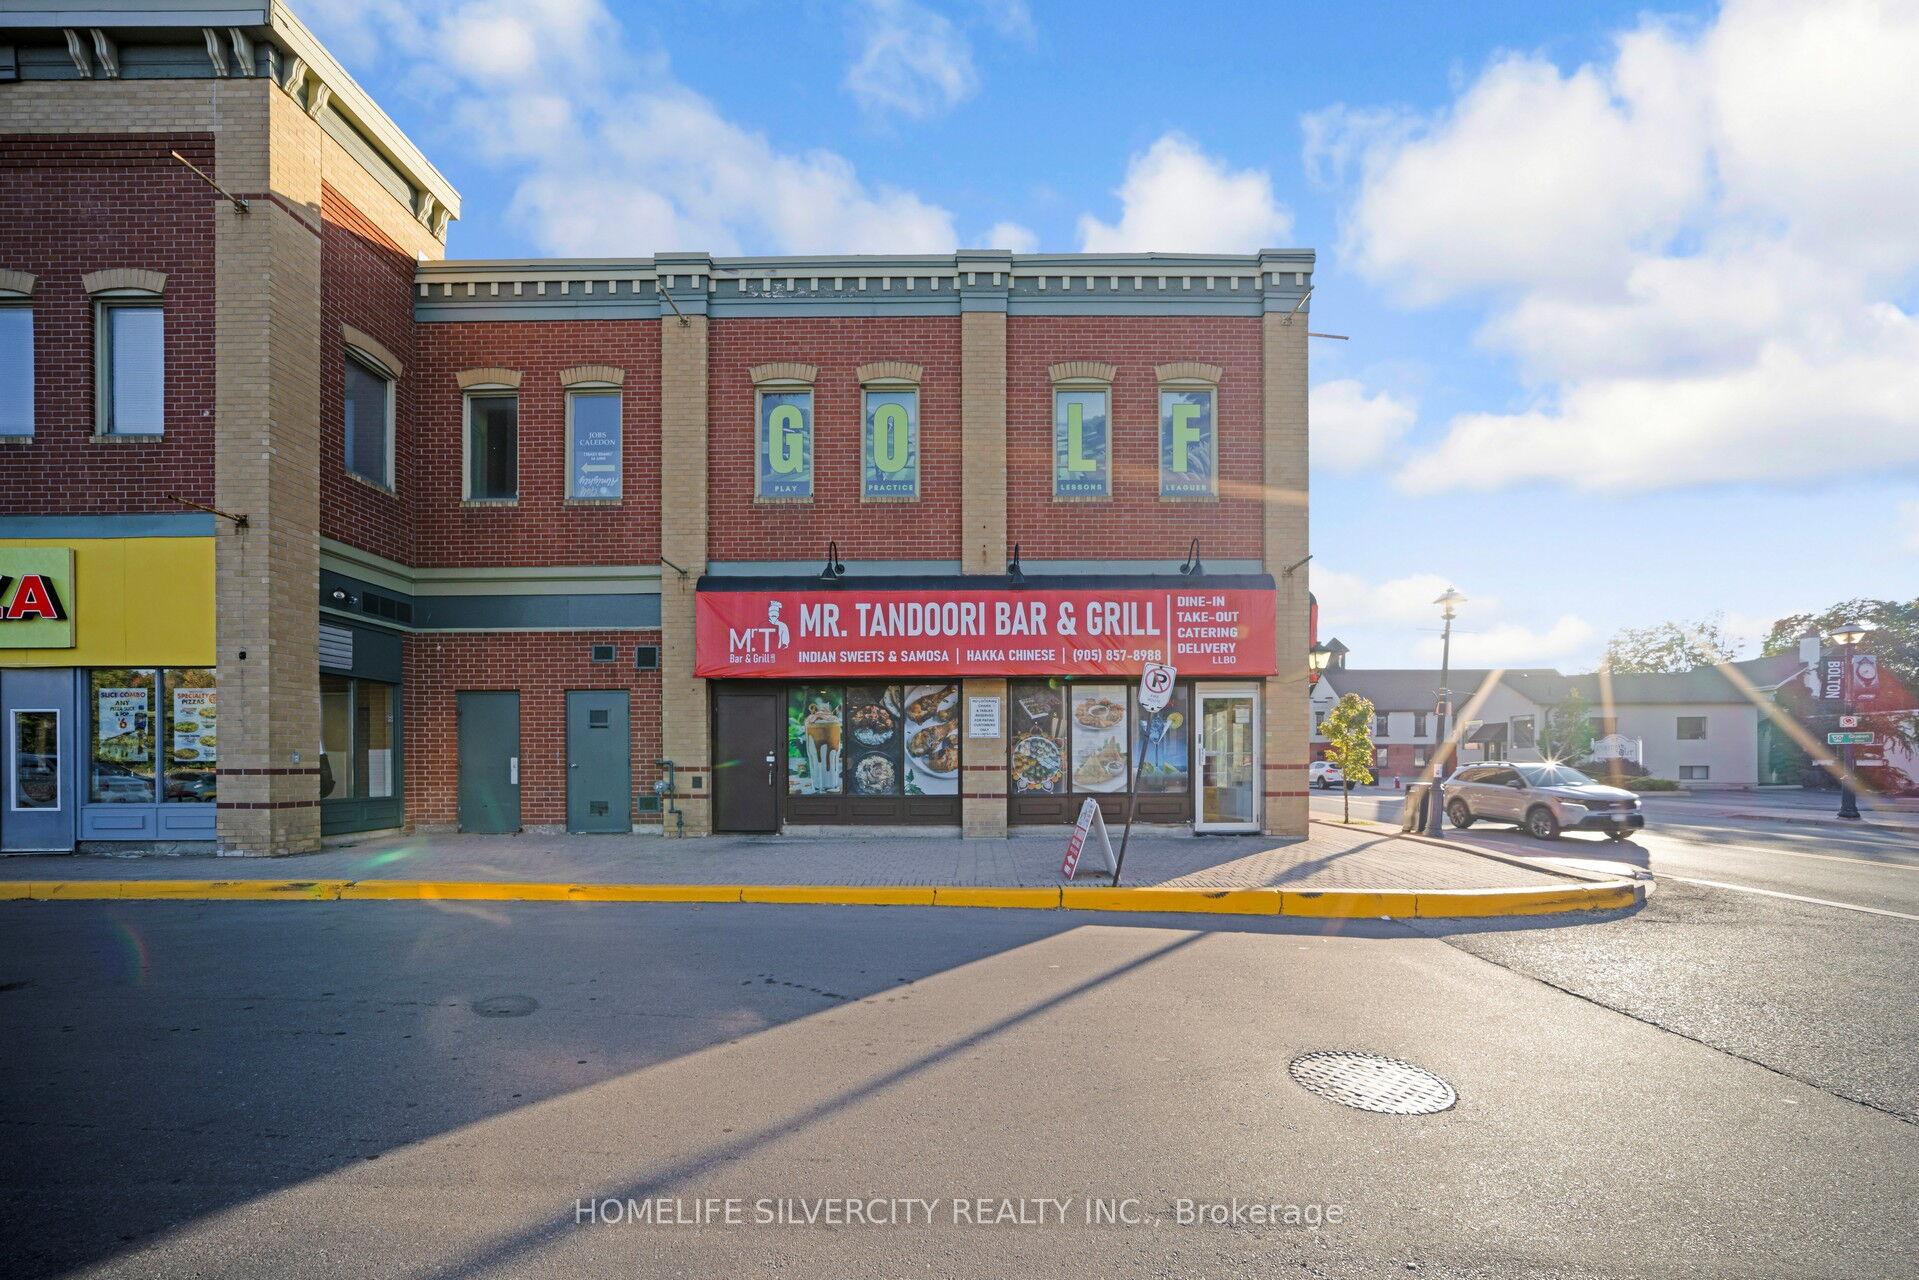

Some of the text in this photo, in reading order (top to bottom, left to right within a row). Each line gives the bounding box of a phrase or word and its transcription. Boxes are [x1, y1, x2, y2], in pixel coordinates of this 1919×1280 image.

[589, 431, 607, 439] JOBS
[1177, 596, 1225, 607] DINE-IN
[800, 601, 1161, 637] MR. TANDOORI BAR & GRILL
[1177, 611, 1239, 623] TAKE-OUT
[1177, 627, 1239, 638] CATERING
[1177, 643, 1236, 654] DELIVERY
[729, 653, 743, 664] Bar
[745, 653, 752, 664] &
[753, 653, 770, 664] Grill
[799, 649, 1162, 663] INDIAN SWEETS & SAMOSA HAKKA CHINESE (905) 857-8988
[1825, 661, 1840, 698] BOLTON
